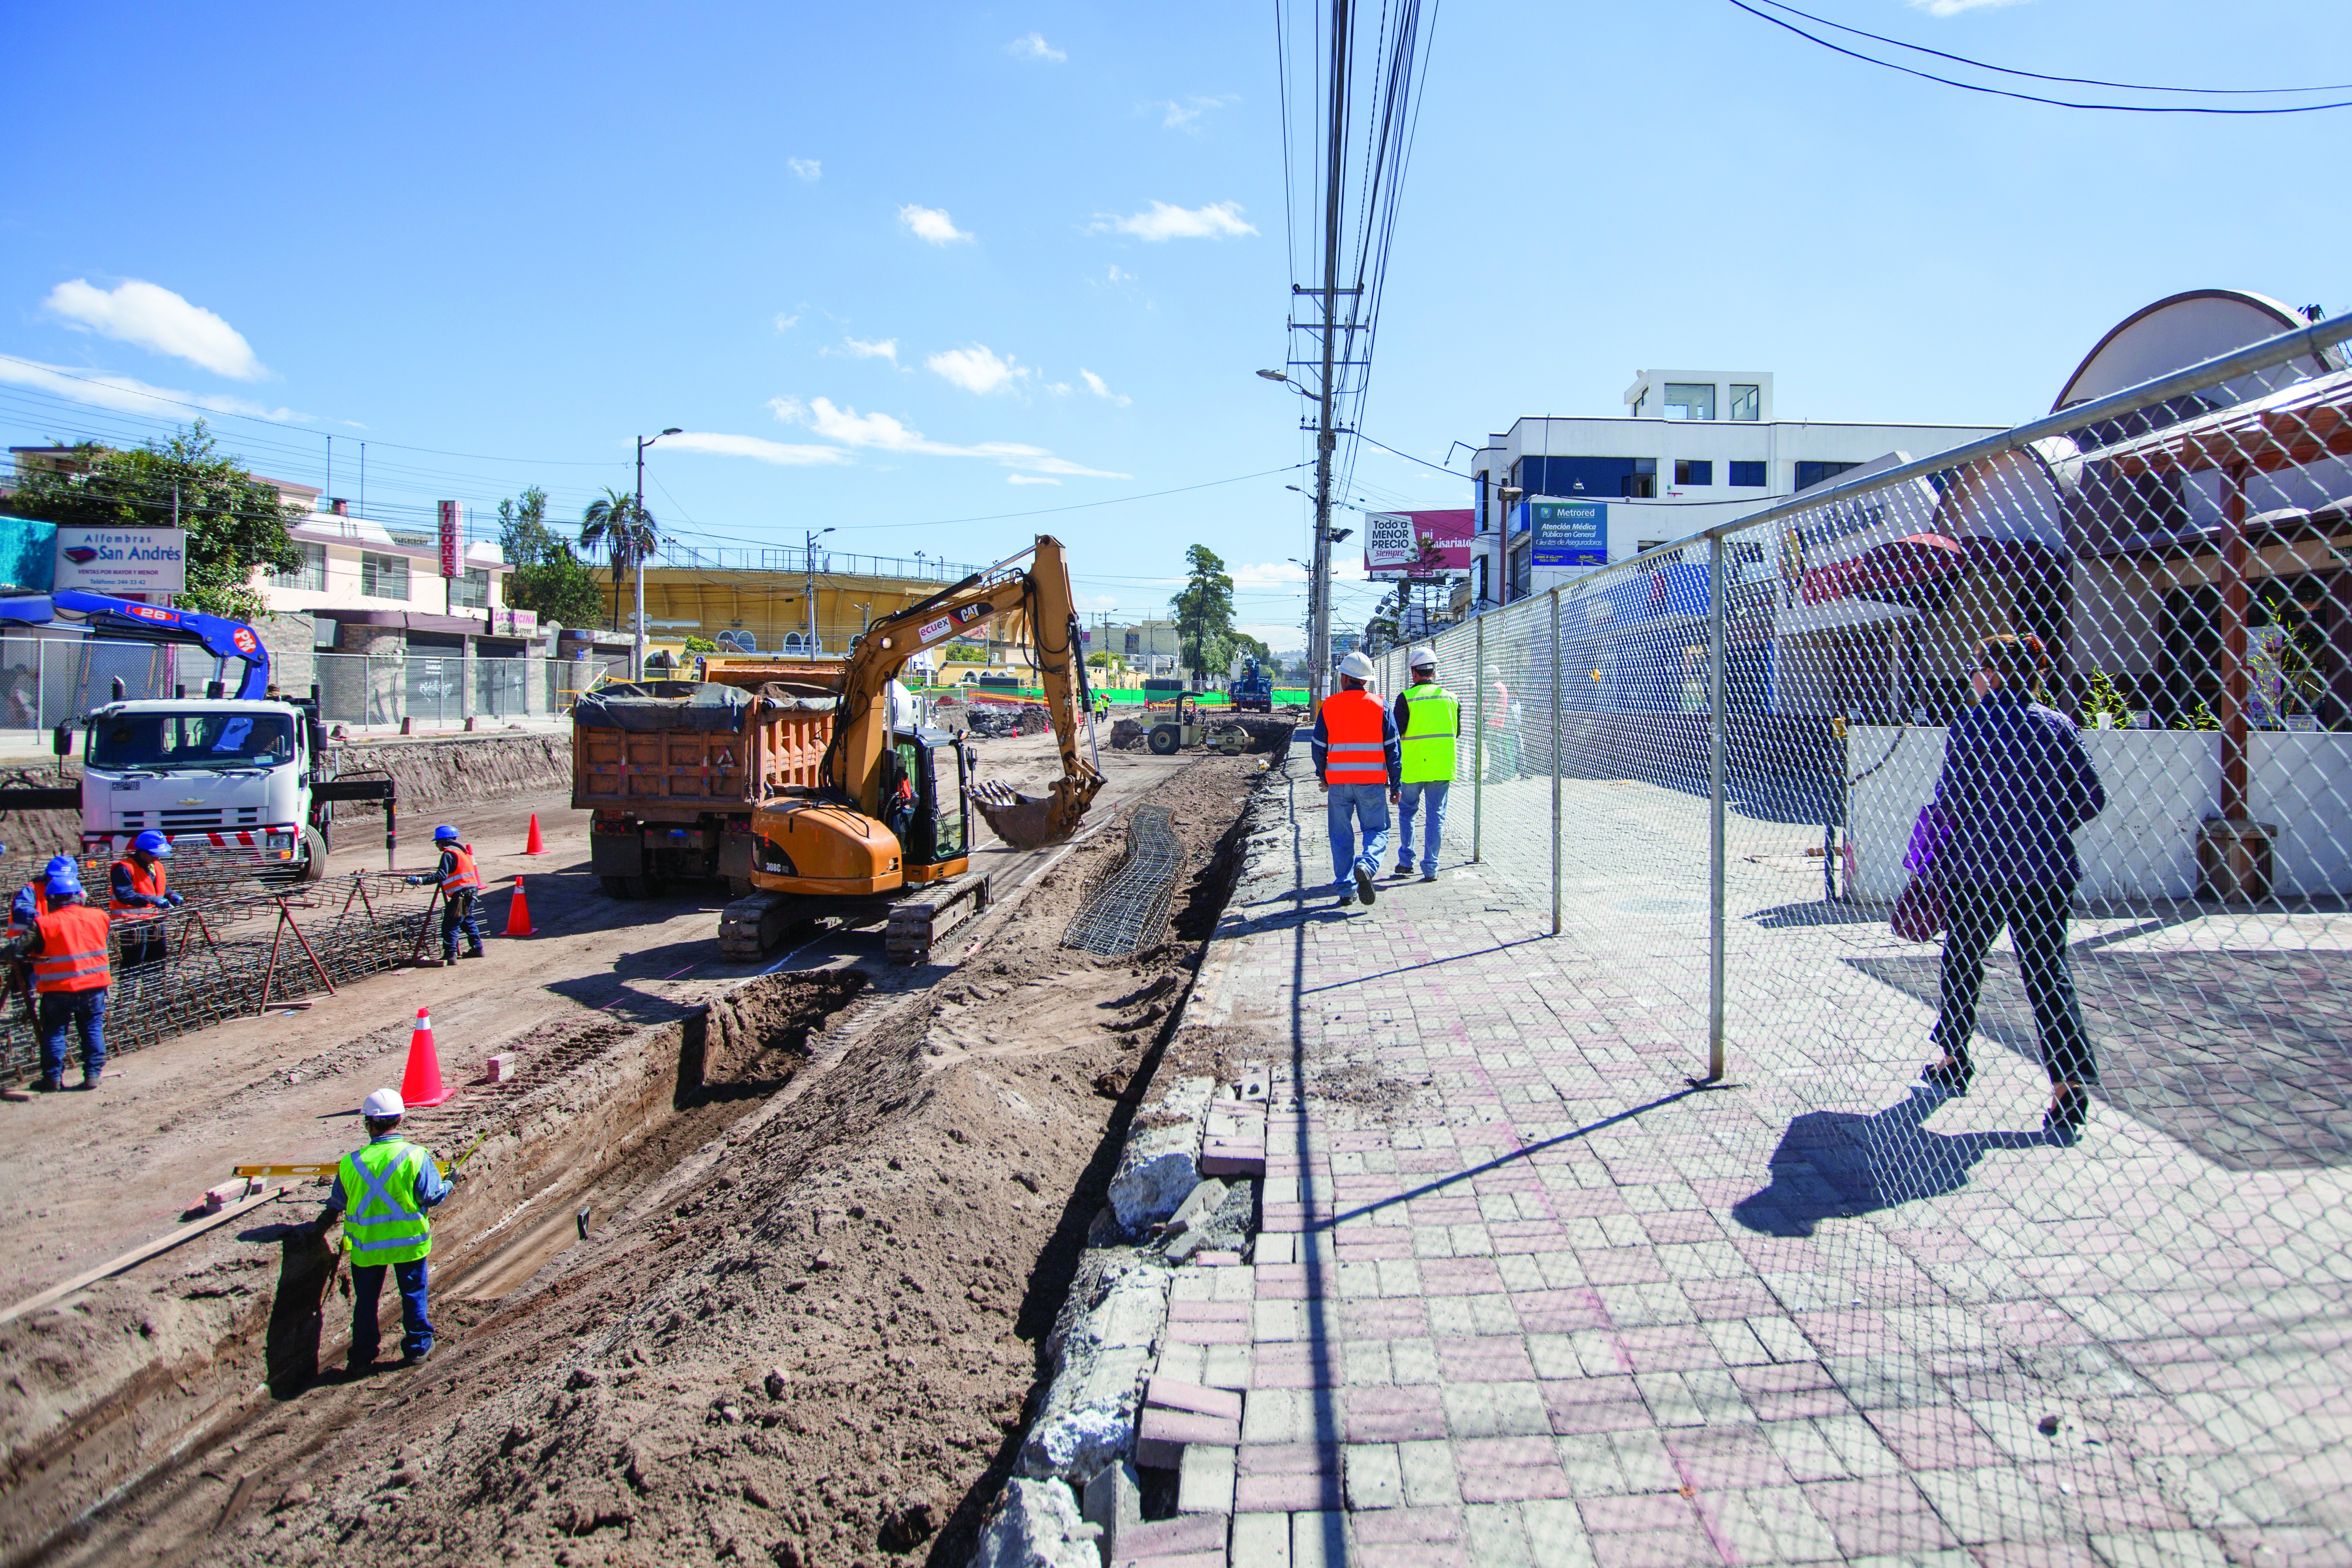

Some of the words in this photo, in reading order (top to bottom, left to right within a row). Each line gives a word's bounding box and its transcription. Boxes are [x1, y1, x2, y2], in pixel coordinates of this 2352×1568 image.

[1374, 520, 1398, 529] Todo
[84, 534, 151, 543] Alfombras
[441, 502, 454, 576] LICORES
[1372, 529, 1408, 539] MENOR
[1422, 528, 1433, 539] mi
[1372, 539, 1409, 549] PRECIO
[99, 545, 123, 560] San
[128, 546, 181, 560] Andrés
[1376, 548, 1405, 558] siempre
[141, 608, 166, 620] 26
[495, 612, 504, 621] LA
[506, 613, 535, 624] OFICINA
[961, 604, 979, 622] CAT
[920, 618, 949, 636] ecuex
[235, 630, 256, 652] PM
[766, 862, 781, 872] 308C
